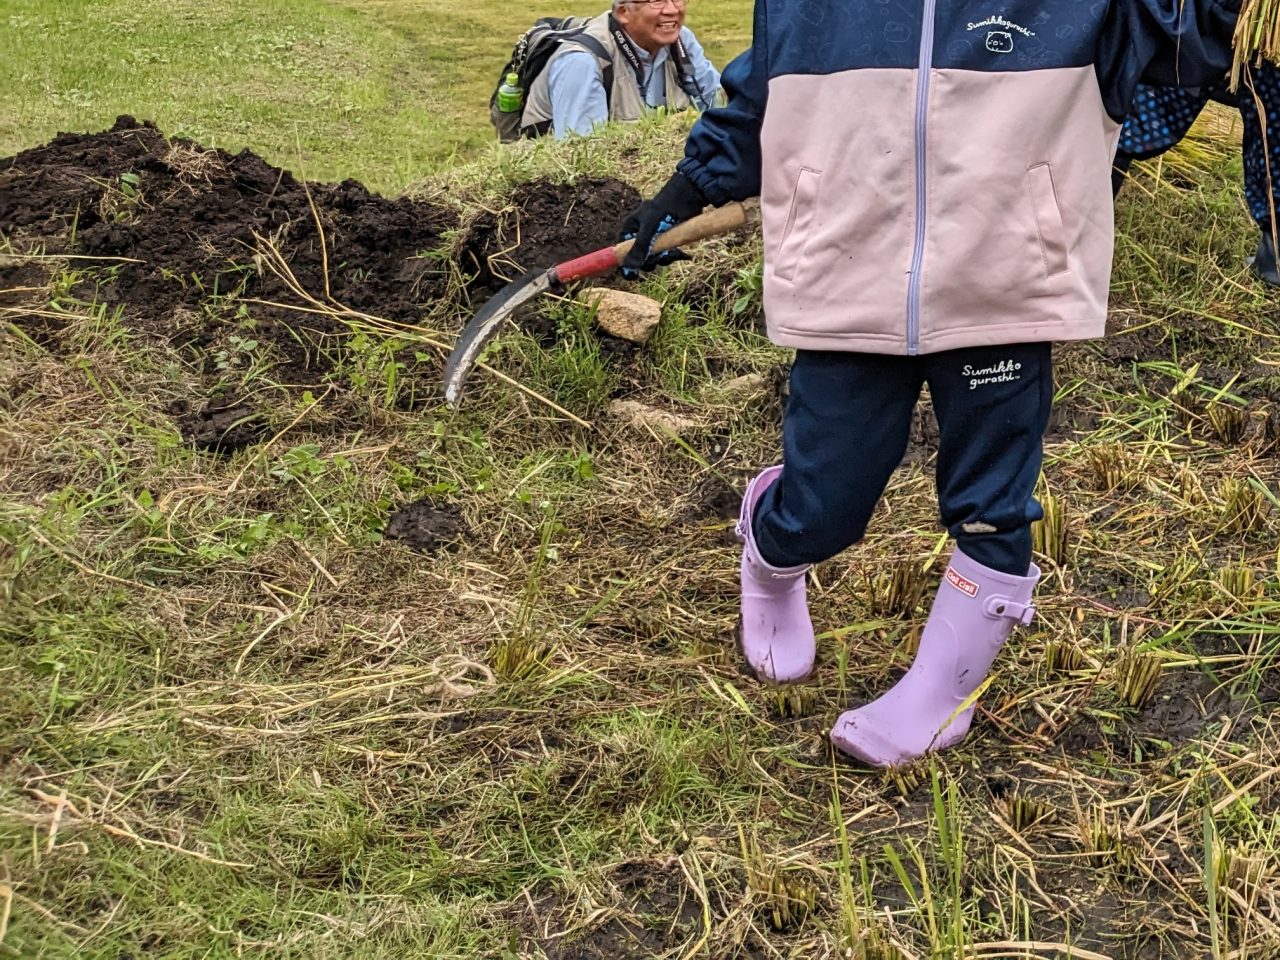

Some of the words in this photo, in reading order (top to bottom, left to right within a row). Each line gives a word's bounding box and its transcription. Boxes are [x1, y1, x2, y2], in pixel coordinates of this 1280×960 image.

[966, 15, 1030, 36] Sumikkogurashi
[615, 30, 625, 44] EOS
[622, 43, 639, 69] DIGITAL
[962, 359, 1021, 376] Sumikko
[969, 372, 1015, 390] gurashi
